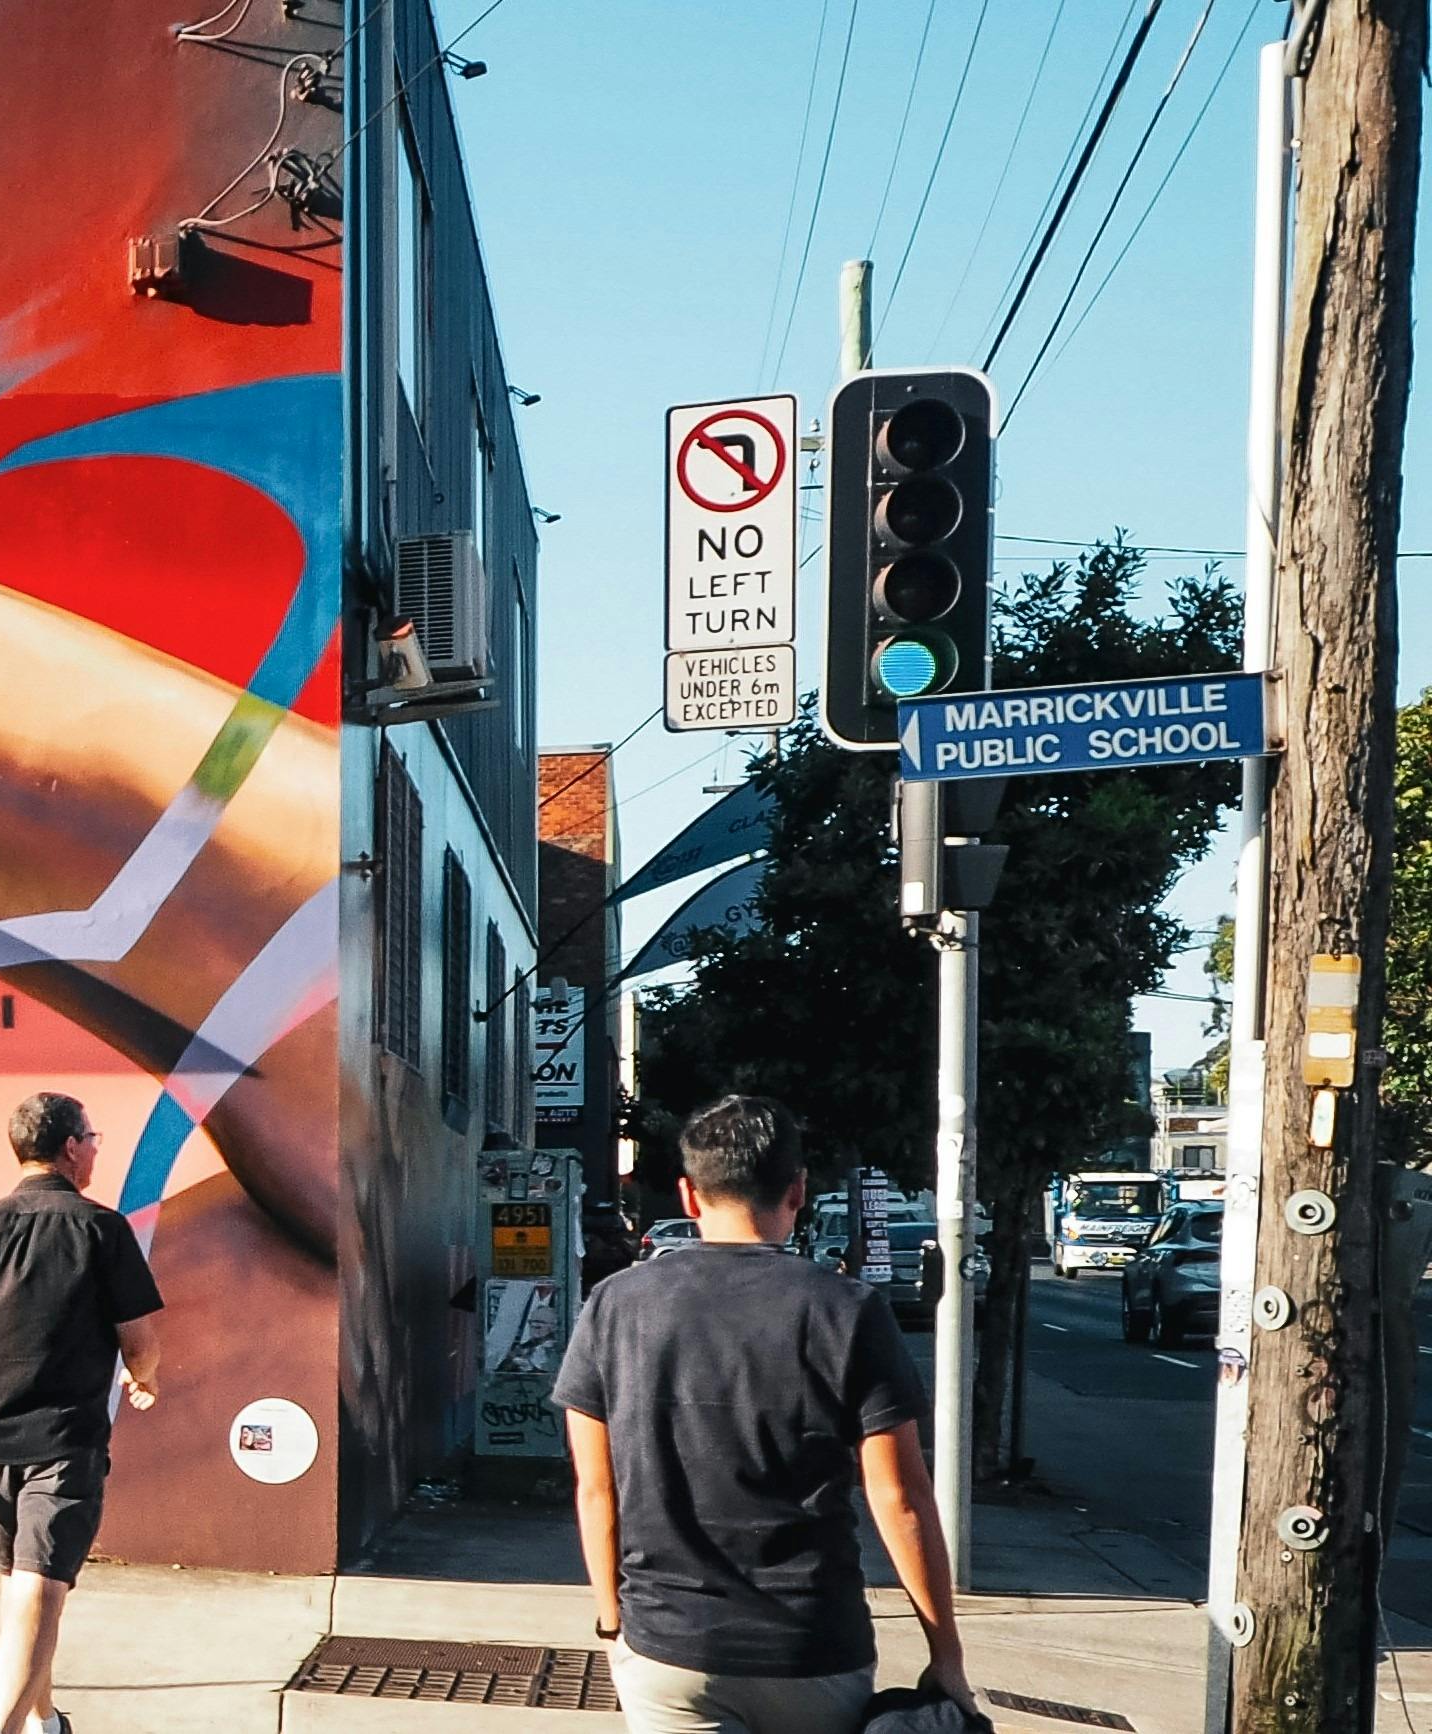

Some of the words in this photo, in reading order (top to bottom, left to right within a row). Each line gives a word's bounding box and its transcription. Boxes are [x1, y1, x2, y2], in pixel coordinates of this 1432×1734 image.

[698, 524, 763, 562] NO
[689, 570, 772, 599] LEFT
[685, 606, 775, 634] TURN
[685, 654, 776, 677] VEHICLES
[680, 679, 741, 699] UNDER
[751, 678, 780, 695] 6m
[683, 699, 778, 721] EXCEPTED
[944, 683, 1228, 732] MARRICKVILLE
[936, 733, 1061, 771] PUBLIC
[1088, 722, 1241, 760] SCHOOL
[497, 1206, 545, 1225] 4951
